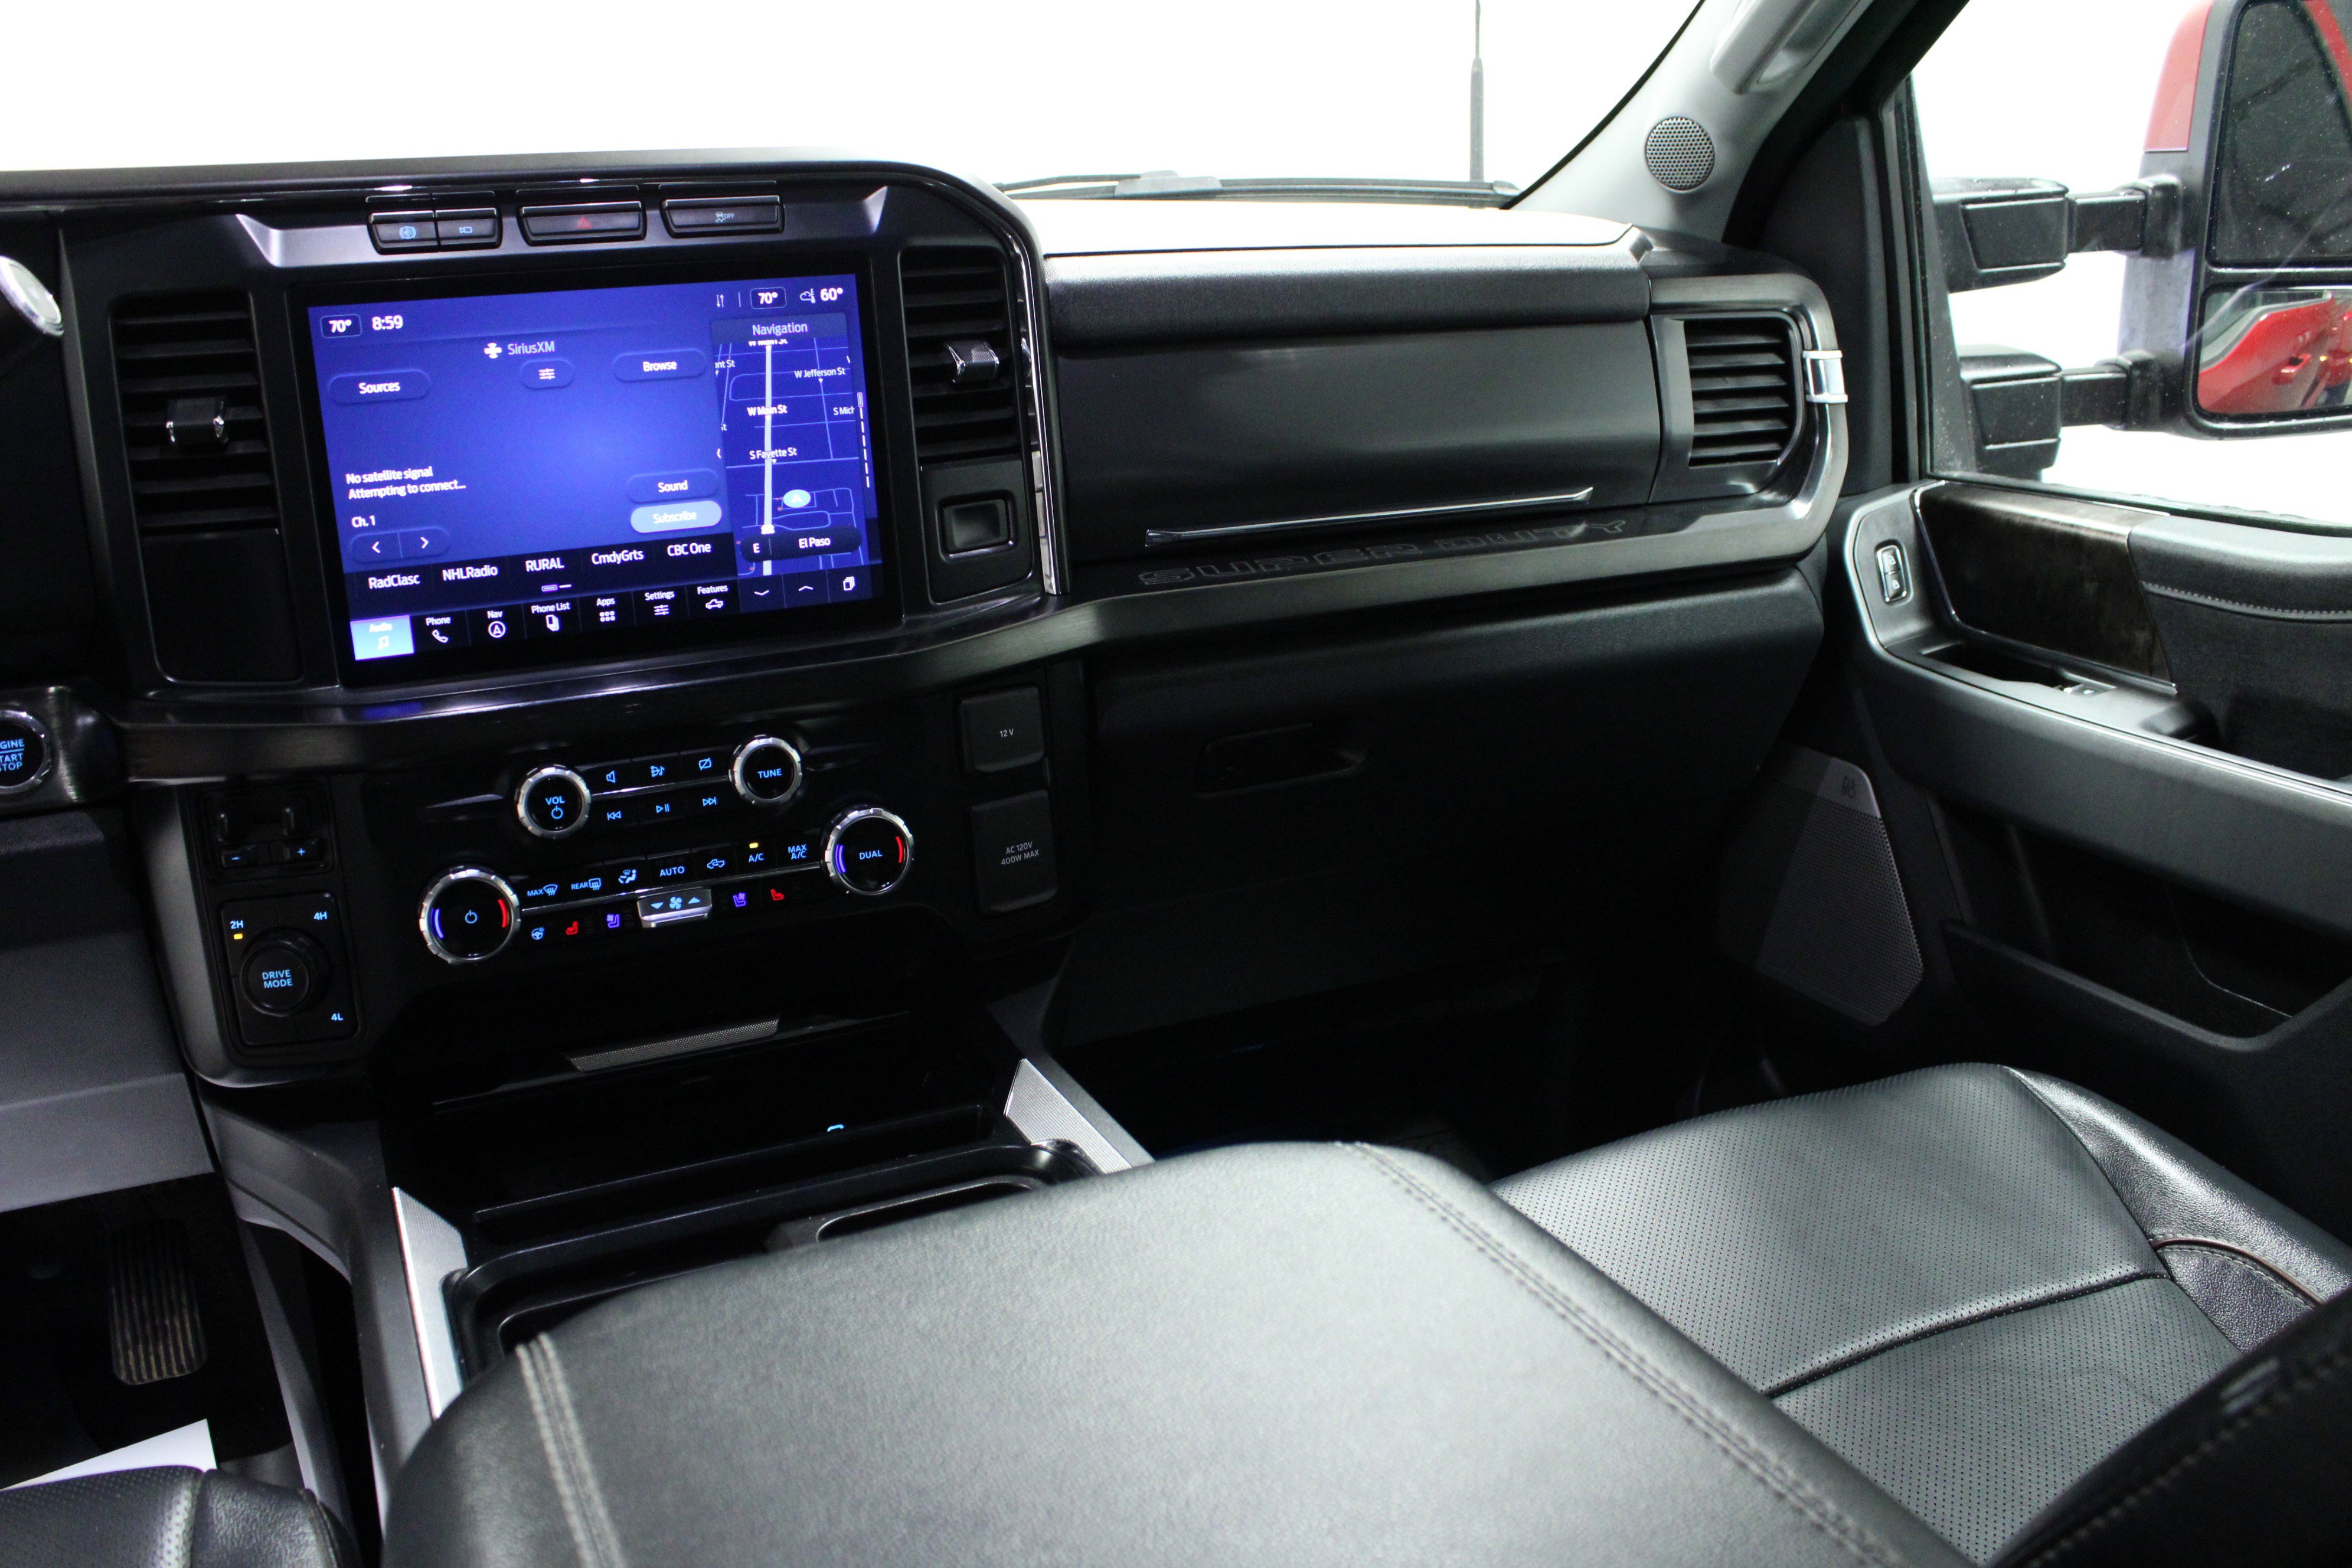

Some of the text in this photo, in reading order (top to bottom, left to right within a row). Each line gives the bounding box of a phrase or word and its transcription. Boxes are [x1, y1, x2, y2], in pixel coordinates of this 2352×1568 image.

[758, 292, 778, 305] 70°
[820, 288, 843, 301] 60°
[329, 319, 352, 333] 70°
[372, 315, 403, 331] 8:59
[752, 323, 808, 336] Navigation
[507, 341, 555, 355] SiriusXM
[643, 361, 677, 373] Browse
[726, 360, 735, 368] St
[794, 367, 845, 378] W Jefferson St
[358, 381, 400, 394] Sources
[747, 404, 787, 416] W Main St
[833, 407, 838, 416] S
[749, 447, 797, 460] S Fayette St
[345, 466, 433, 484] No satellite signal
[348, 485, 406, 499] Attempting
[407, 483, 419, 494] to
[658, 479, 688, 492] Sound
[351, 515, 375, 528] Ch. 1
[652, 511, 697, 524] Subscribe
[753, 544, 760, 553] E
[799, 537, 831, 548] El Paso
[667, 542, 711, 557] CBC One
[592, 549, 644, 565] CmdyGrts
[525, 557, 564, 572] RURAL
[1139, 543, 1423, 584] SUPER
[442, 564, 498, 581] NHLRadio
[368, 574, 420, 589] RadClasc
[697, 584, 728, 594] Features
[596, 597, 615, 607] Apps
[645, 590, 675, 602] Settings
[531, 602, 570, 614] Phone List
[487, 610, 502, 619] Nav
[369, 622, 393, 632] Audio
[426, 616, 451, 626] Phone
[999, 729, 1008, 738] 12
[757, 769, 782, 779] TUNE
[545, 796, 565, 805] VOL
[788, 844, 807, 854] MAX
[1006, 841, 1033, 854] AC 120V
[749, 853, 764, 863] A/C
[790, 850, 806, 860] A/C
[859, 850, 883, 860] DUAL
[1001, 849, 1040, 865] 400W MAX
[659, 866, 685, 877] AUTO
[571, 882, 588, 890] REAR
[313, 911, 327, 920] 4H
[230, 920, 244, 929] 2H
[262, 969, 291, 980] DRIVE
[264, 978, 293, 988] MODE
[331, 1012, 343, 1021] 4L
